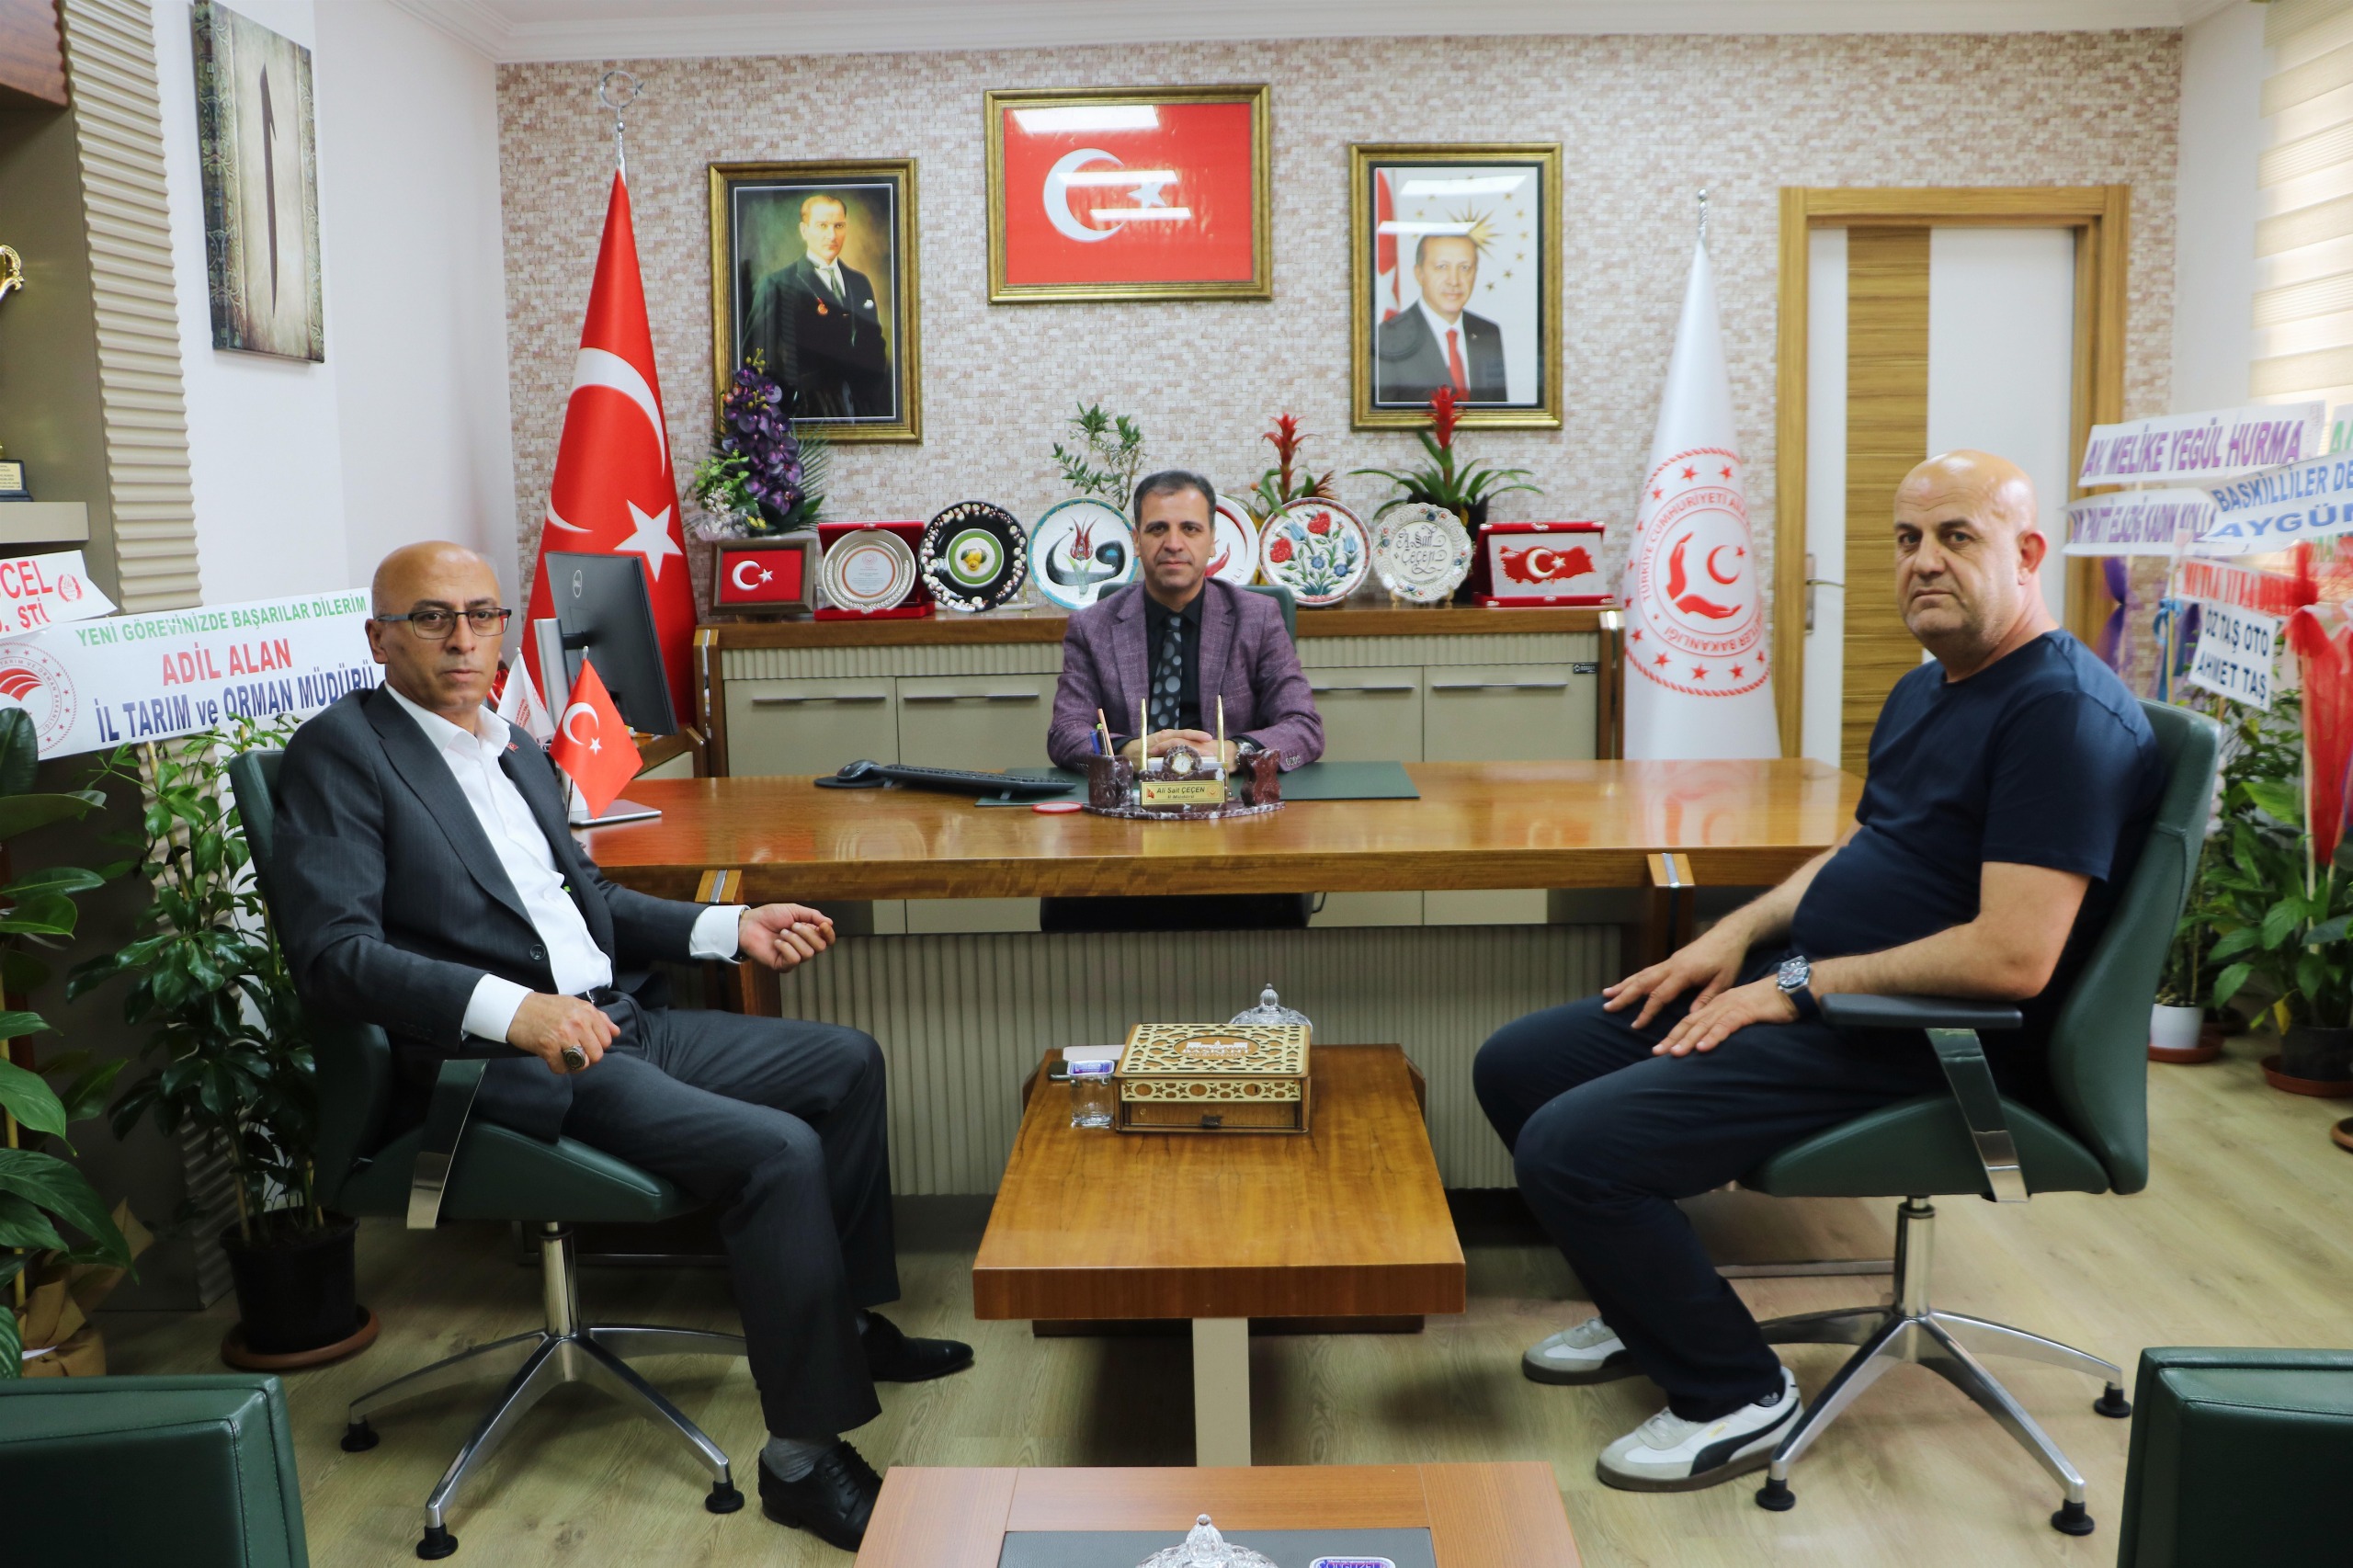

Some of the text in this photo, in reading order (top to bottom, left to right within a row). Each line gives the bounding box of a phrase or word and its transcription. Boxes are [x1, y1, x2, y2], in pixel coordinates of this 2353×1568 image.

[2105, 424, 2169, 474] MELİKE
[2168, 417, 2224, 471] YEGÜL
[2226, 420, 2304, 467] HURMA
[2211, 464, 2329, 512] BASKİLLİLER
[1640, 547, 1653, 602] TÜRKİYE
[1651, 491, 1727, 542] CUMHURİYETİ
[0, 560, 53, 599] CEL
[75, 593, 367, 646] YENİ GÖREVİNİZDE BAŞARILAR DİLERİM
[1665, 626, 1735, 652] BAKANLIĞI
[2244, 623, 2268, 657] OTO
[38, 667, 57, 691] ORMAN
[162, 638, 292, 686] ADİL ALAN
[2195, 651, 2267, 706] AHMET TAŞ
[42, 694, 60, 731] BAKANLIĞI
[94, 659, 375, 743] İL TARIM ve ORMAN MÜDÜRÜ
